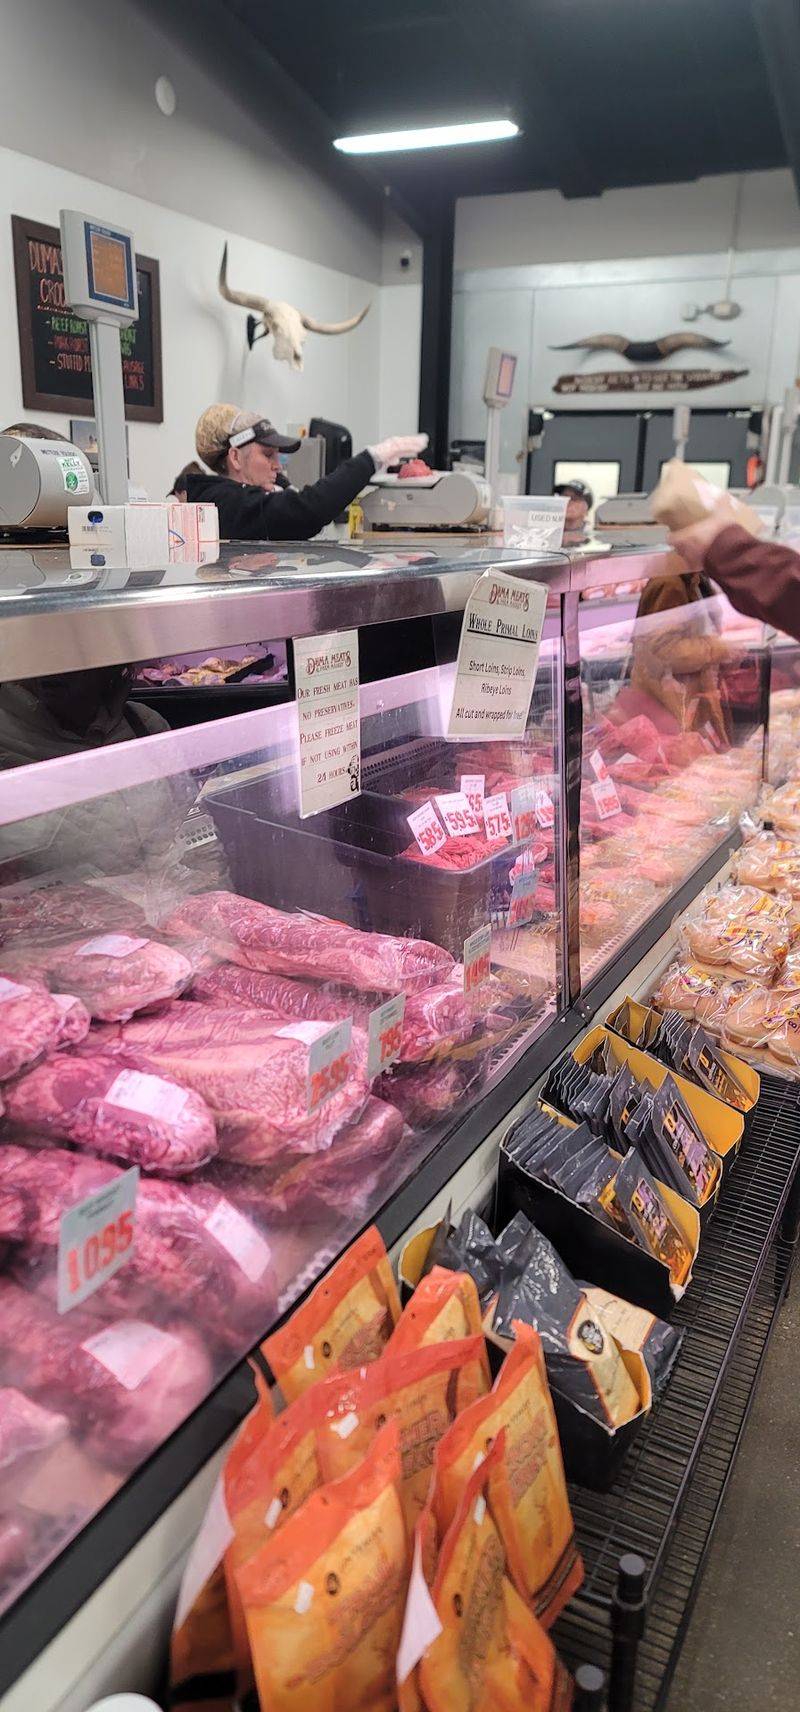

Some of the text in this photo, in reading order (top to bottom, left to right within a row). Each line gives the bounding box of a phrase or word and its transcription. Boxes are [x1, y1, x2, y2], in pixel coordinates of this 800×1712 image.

[469, 612, 492, 632] WHOLE
[496, 618, 518, 637] PRIMAL
[469, 660, 484, 672] Short
[501, 664, 512, 678] Strip
[313, 684, 331, 696] FRESH
[333, 680, 347, 691] MEAT
[481, 683, 512, 697] Ribeye Loins
[456, 707, 464, 719] All
[465, 709, 473, 719] cut
[474, 709, 485, 719] and
[485, 709, 505, 722] wrapped
[300, 730, 322, 745] PLEASE
[324, 724, 344, 738] FREEZE
